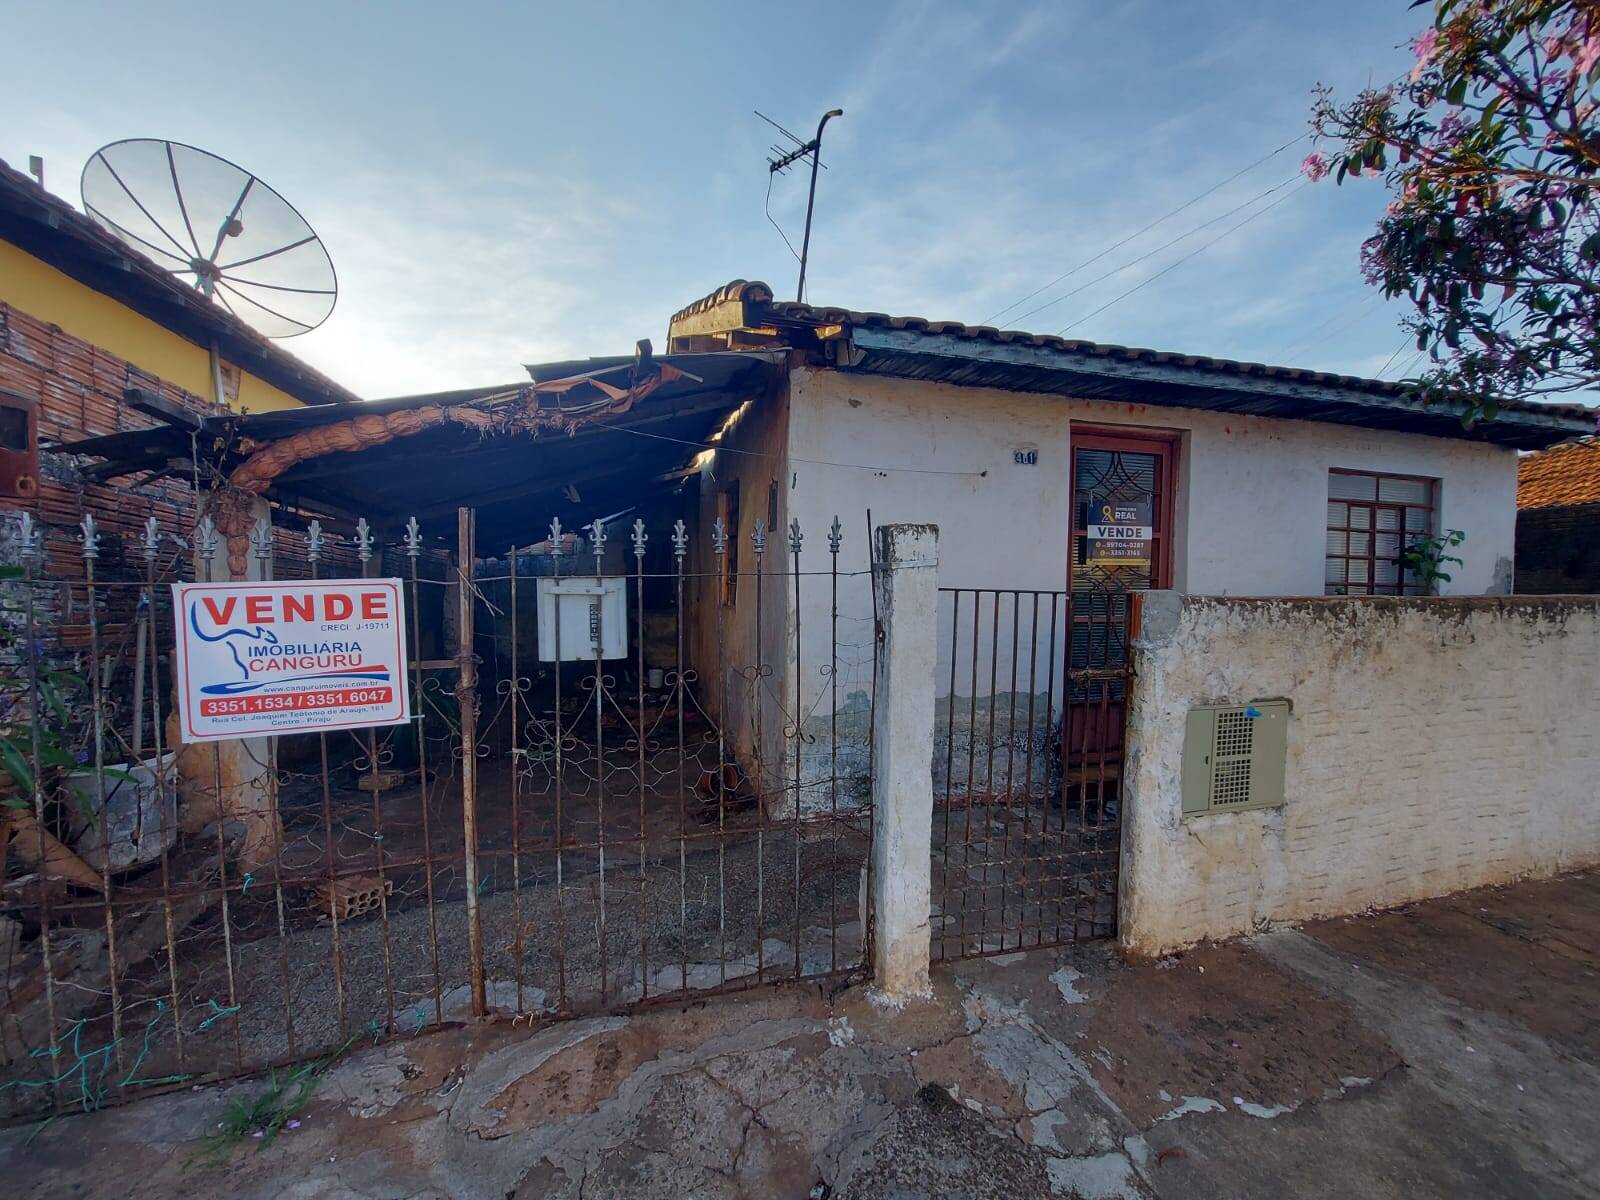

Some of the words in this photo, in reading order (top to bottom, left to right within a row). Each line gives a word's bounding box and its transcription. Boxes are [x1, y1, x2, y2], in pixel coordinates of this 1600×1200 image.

[1115, 511, 1137, 520] REAL
[1097, 527, 1142, 538] VENDE
[202, 593, 388, 625] VENDE
[355, 622, 390, 631] J-19711
[248, 640, 362, 658] IMOBILIÁRIA
[250, 654, 362, 672] CANGURU
[207, 697, 294, 714] 3351.1534
[306, 690, 386, 706] 3351.6047
[251, 712, 288, 722] Joaquim
[271, 718, 300, 726] Centro
